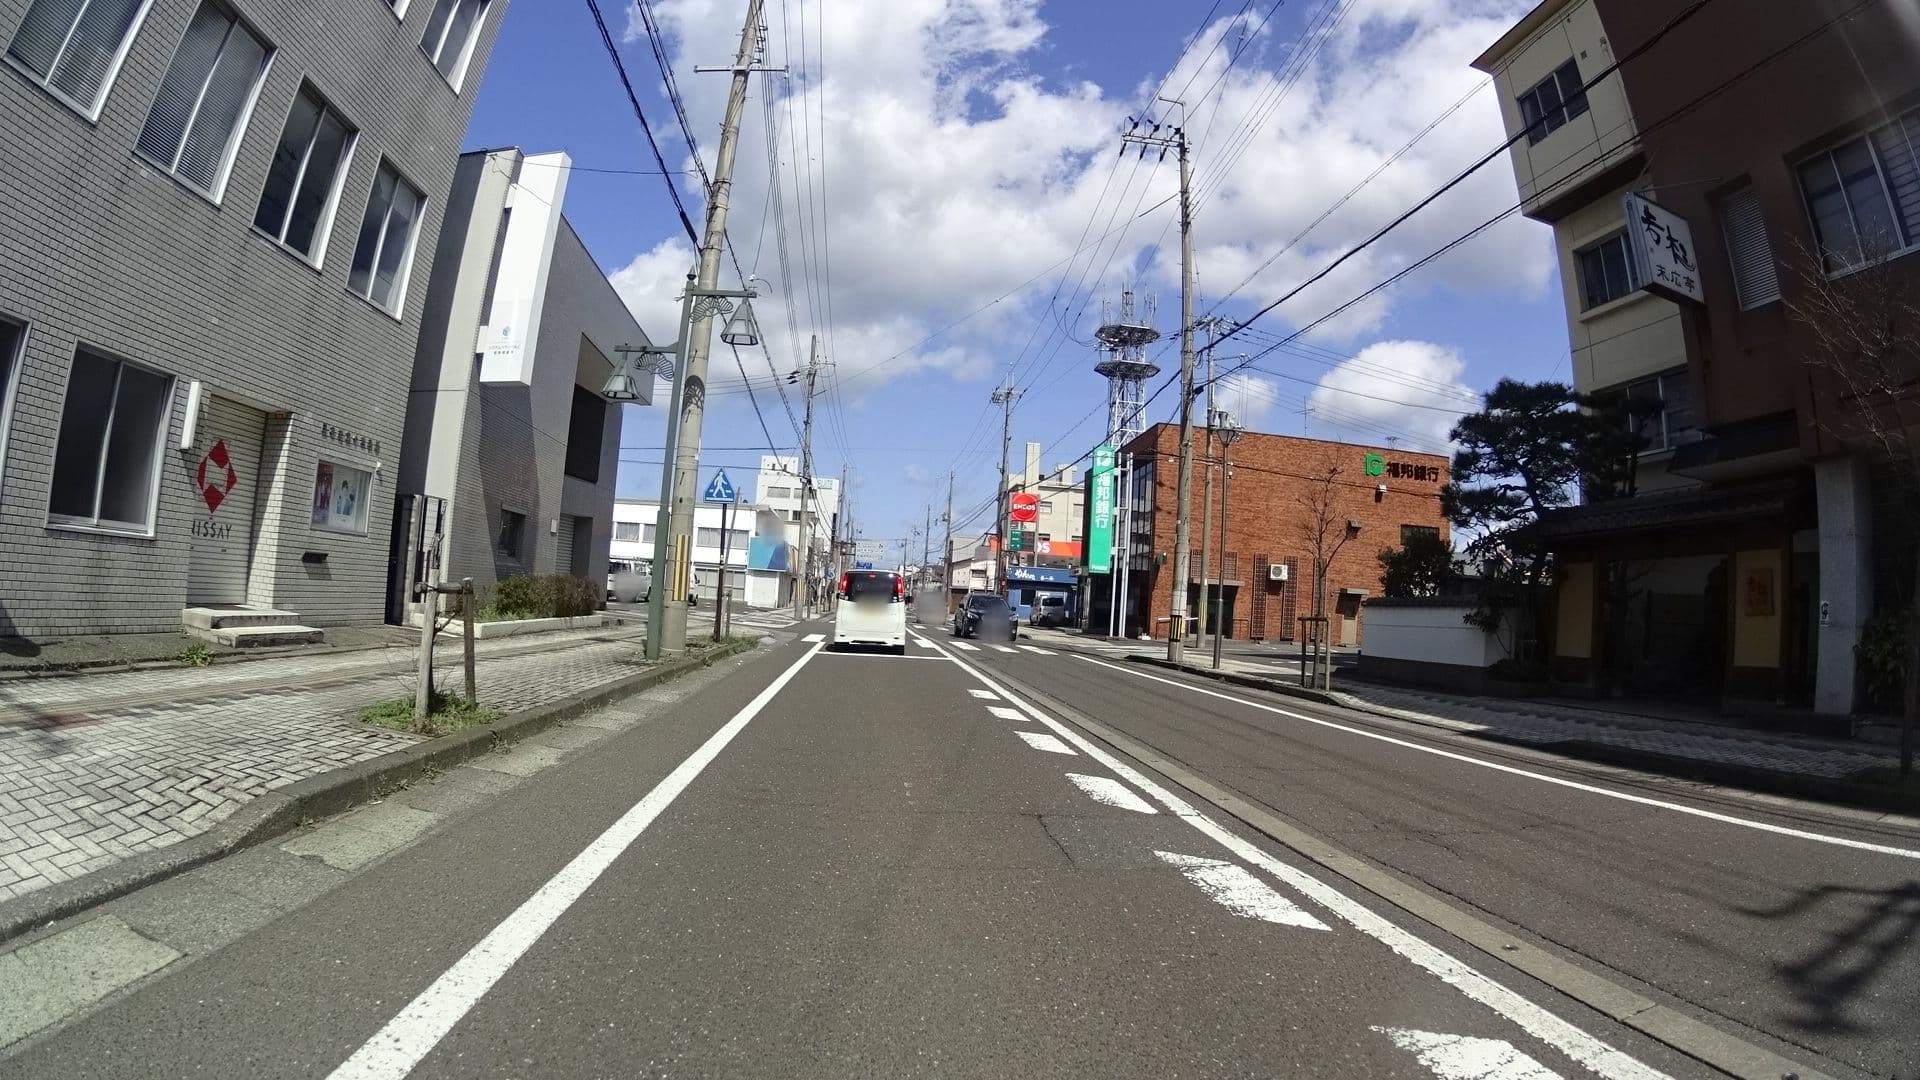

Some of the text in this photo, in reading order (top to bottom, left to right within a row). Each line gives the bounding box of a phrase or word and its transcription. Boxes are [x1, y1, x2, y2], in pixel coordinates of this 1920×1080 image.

[1386, 461, 1440, 482] 福邦銀行
[1095, 472, 1111, 529] 福邦銀行
